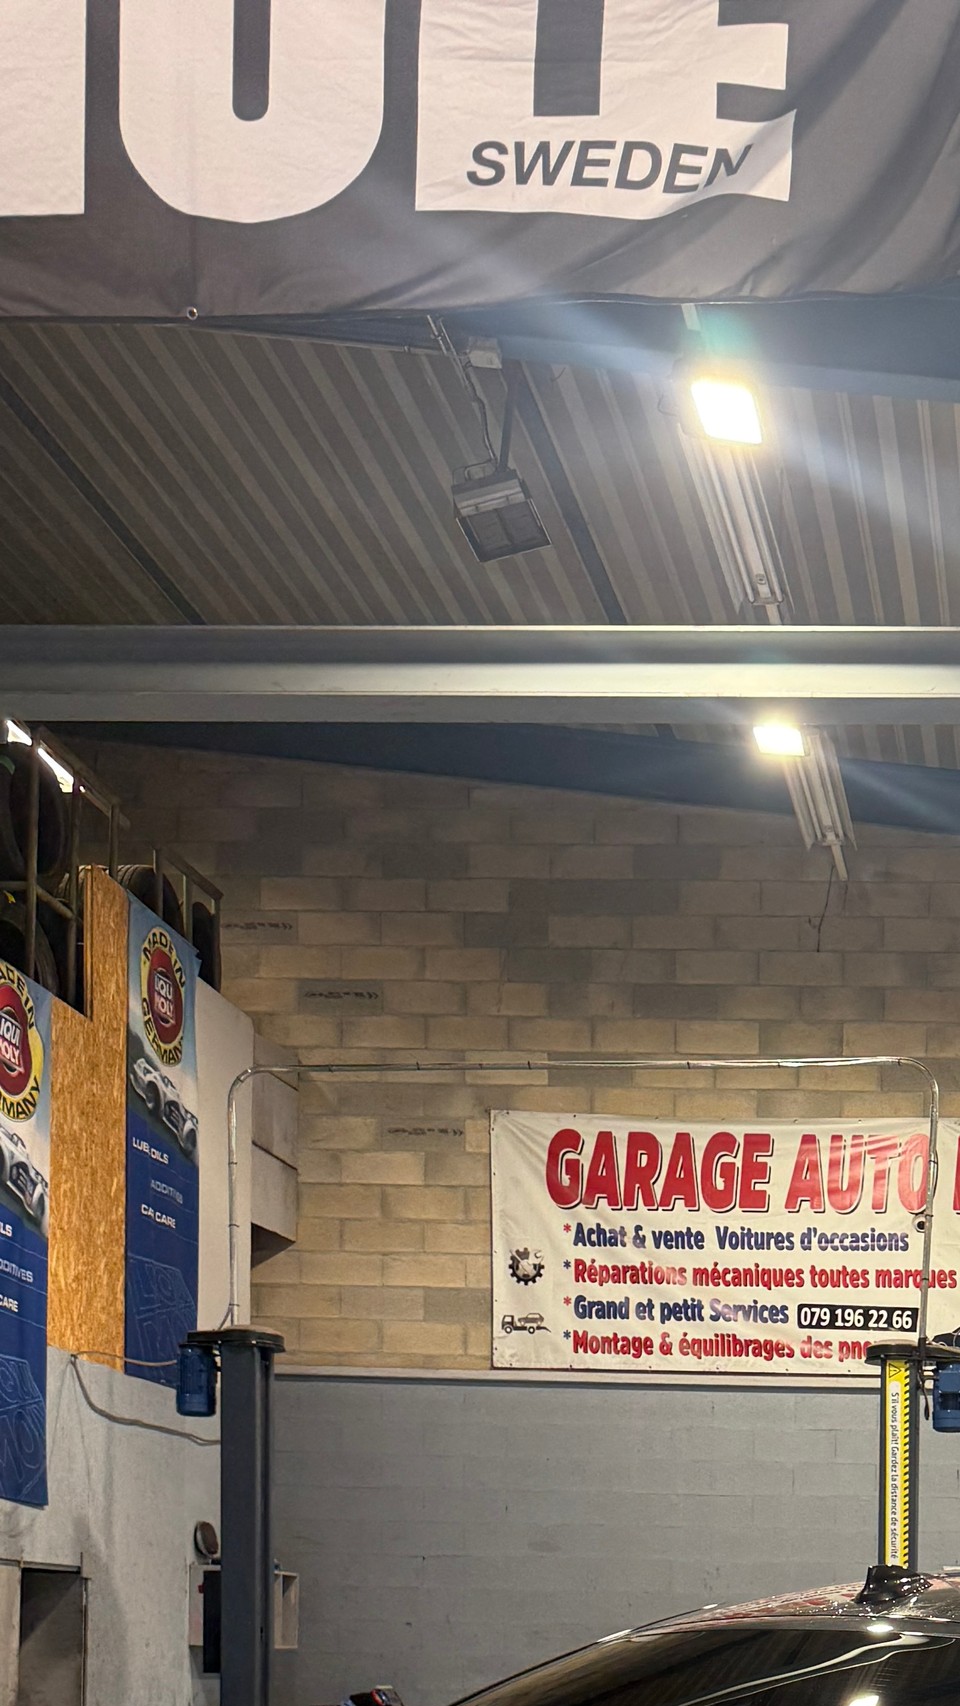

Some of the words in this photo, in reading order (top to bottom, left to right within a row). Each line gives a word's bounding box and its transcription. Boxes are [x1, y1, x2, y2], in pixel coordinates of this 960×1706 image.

[465, 140, 753, 195] SWEDEN
[545, 1128, 774, 1213] GARAGE
[784, 1132, 930, 1214] AUTO
[573, 1223, 628, 1250] Achat
[632, 1223, 646, 1250] &
[651, 1227, 705, 1251] vente
[715, 1226, 795, 1252] Voitures
[800, 1226, 909, 1252] d'occasions
[573, 1259, 687, 1287] Réparations
[692, 1263, 805, 1291] mécaniques
[809, 1265, 869, 1289] toutes
[875, 1268, 957, 1290] marques
[573, 1295, 629, 1321] Grand
[634, 1297, 654, 1321] et
[659, 1296, 704, 1325] petit
[709, 1300, 790, 1324] Services
[799, 1306, 830, 1327] 079
[833, 1307, 864, 1328] 196
[868, 1309, 889, 1329] 22
[891, 1309, 913, 1330] 66
[573, 1329, 654, 1357] Montage
[658, 1332, 673, 1355] &
[678, 1332, 796, 1361] équilibrages
[799, 1335, 833, 1360] des
[891, 1405, 899, 1423] vous
[891, 1446, 899, 1473] Gardez
[891, 1483, 899, 1516] distance
[891, 1517, 899, 1527] de
[891, 1528, 899, 1559] sécurité
